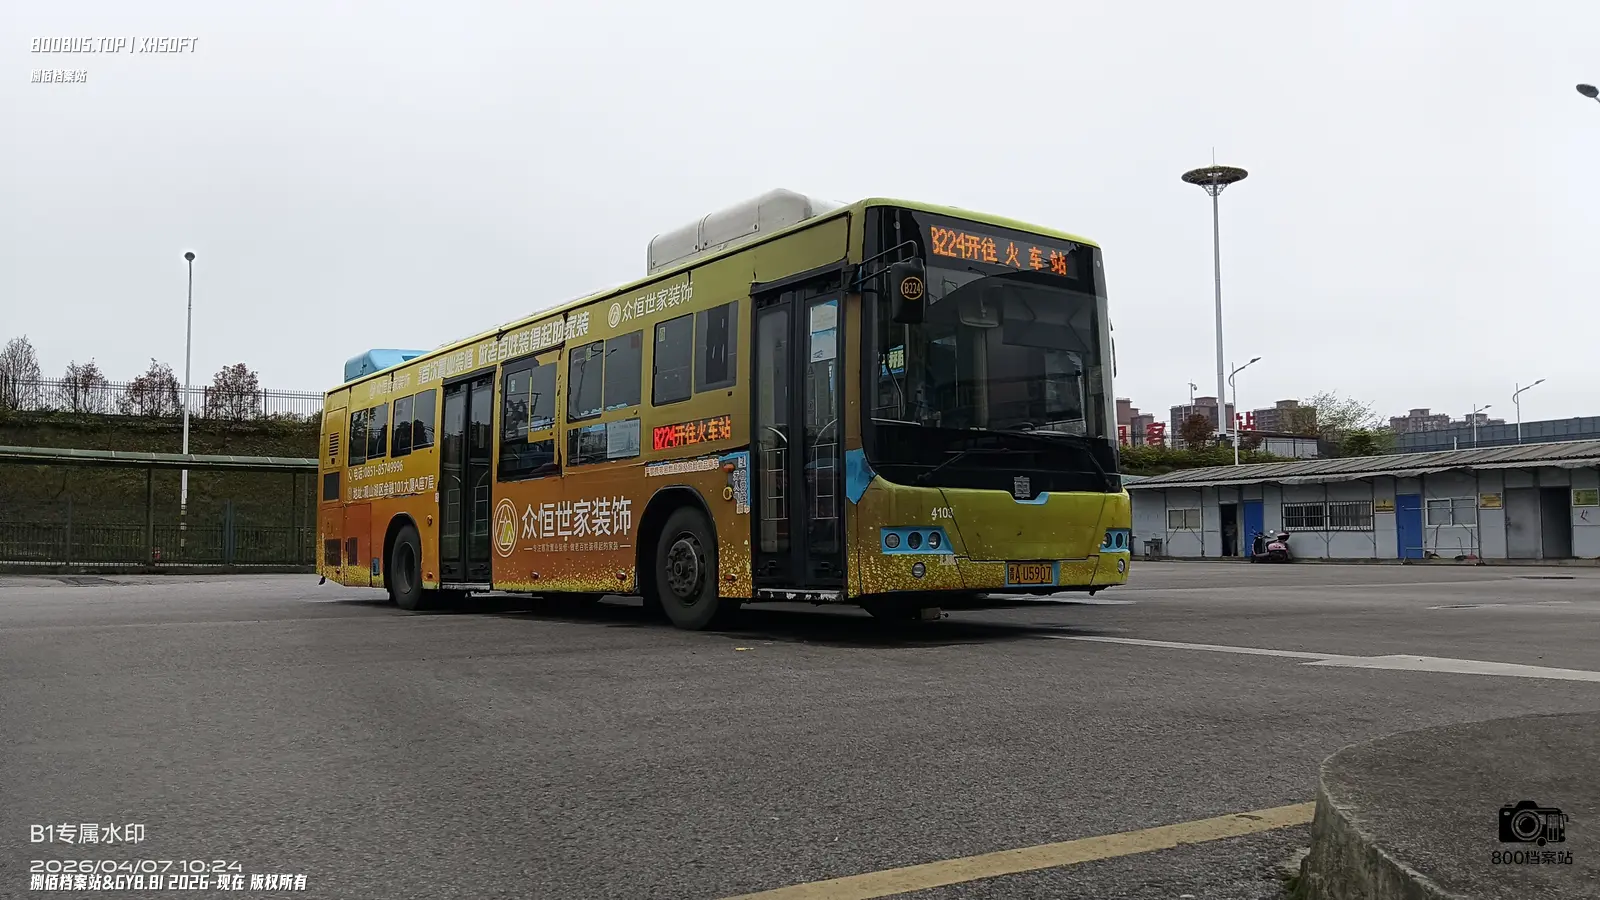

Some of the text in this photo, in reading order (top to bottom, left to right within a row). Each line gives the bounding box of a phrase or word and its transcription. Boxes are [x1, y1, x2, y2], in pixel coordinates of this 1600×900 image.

[621, 281, 694, 323] 众恒世家装饰
[904, 282, 922, 294] B224
[521, 495, 632, 540] 众恒世家装饰
